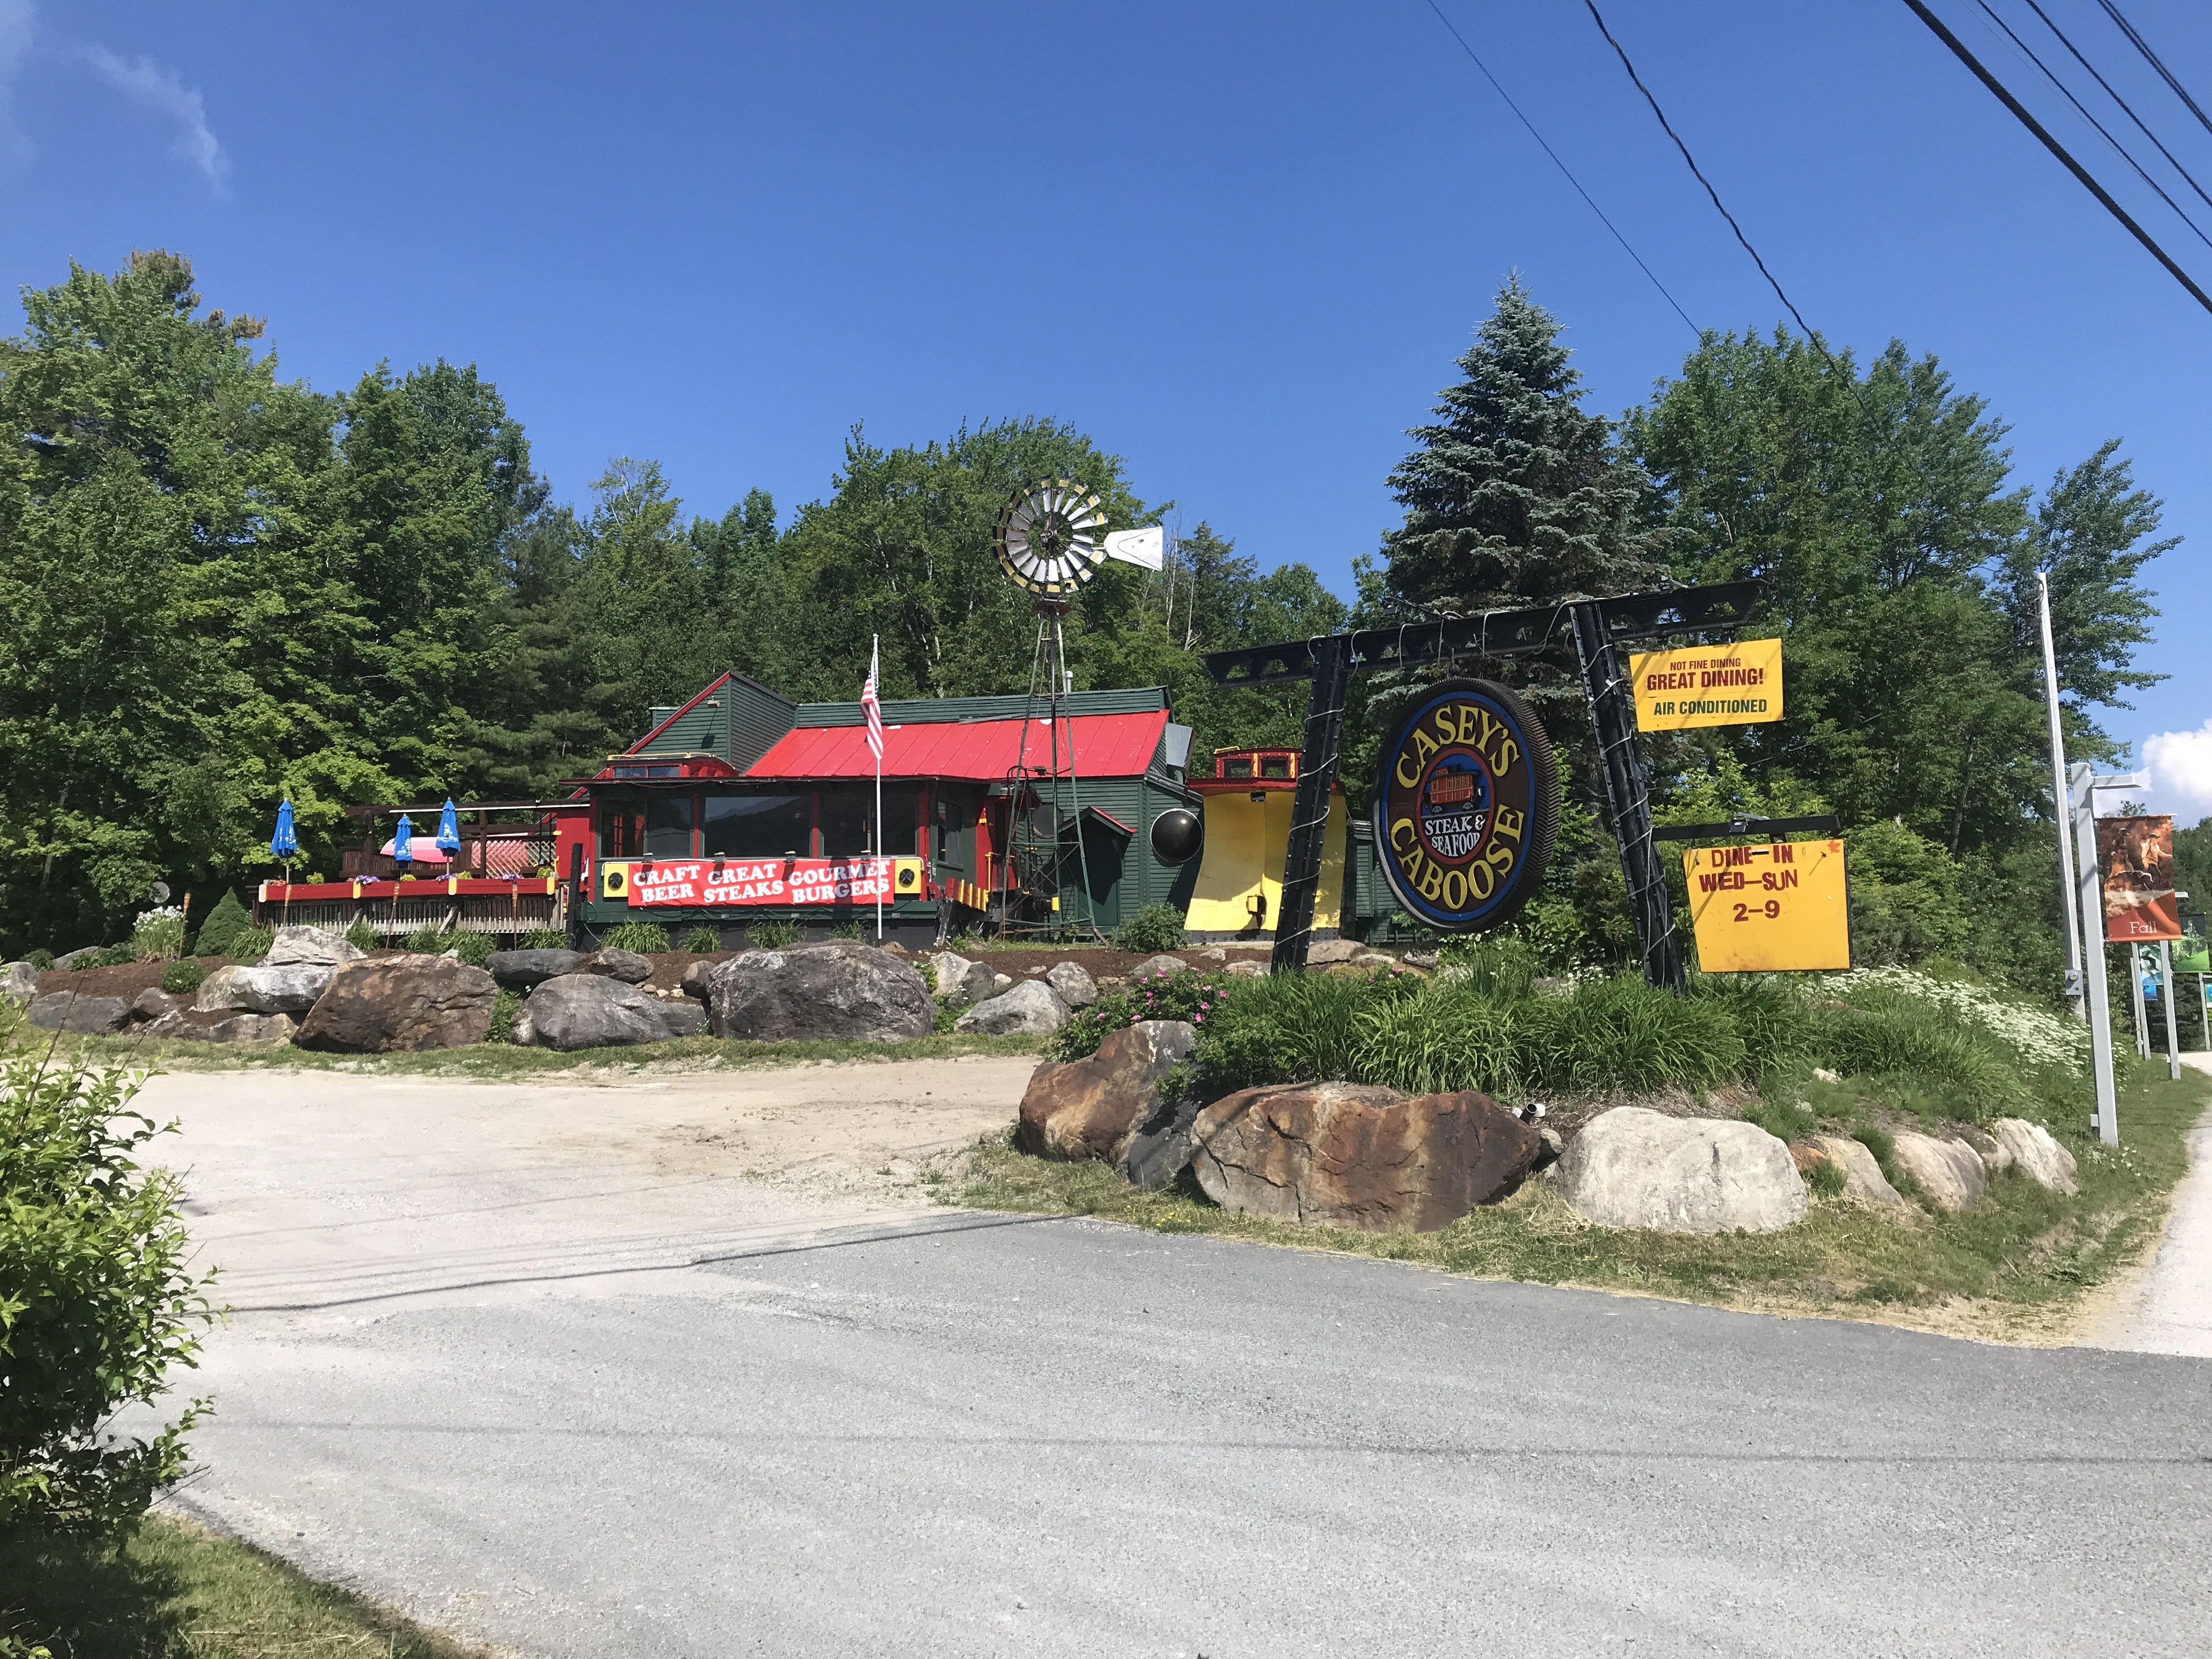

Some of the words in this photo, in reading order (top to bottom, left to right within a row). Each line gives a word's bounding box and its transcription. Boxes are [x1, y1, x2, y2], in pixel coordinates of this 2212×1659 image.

[1670, 661, 1686, 671] NOT
[1689, 660, 1708, 669] FINE
[1711, 658, 1741, 668] DINING
[1647, 672, 1696, 691] GREAT
[1701, 668, 1763, 688] DINING!
[1654, 702, 1675, 715] AIR
[1679, 699, 1767, 714] CONDITIONED
[1396, 704, 1520, 788] CASEY'S
[1425, 816, 1473, 836] STEAK
[1475, 815, 1486, 831] &
[1431, 832, 1480, 857] SEAFOOD
[1391, 804, 1525, 910] CABOOSE
[633, 865, 700, 886] CRAFT
[708, 863, 777, 885] GREAT
[789, 860, 890, 886] GOURMET
[641, 883, 695, 902] BEER
[704, 880, 785, 904] STEAKS
[792, 878, 890, 903] BURGERS
[1733, 900, 1780, 922] 2-9
[2129, 921, 2158, 933] Fall
